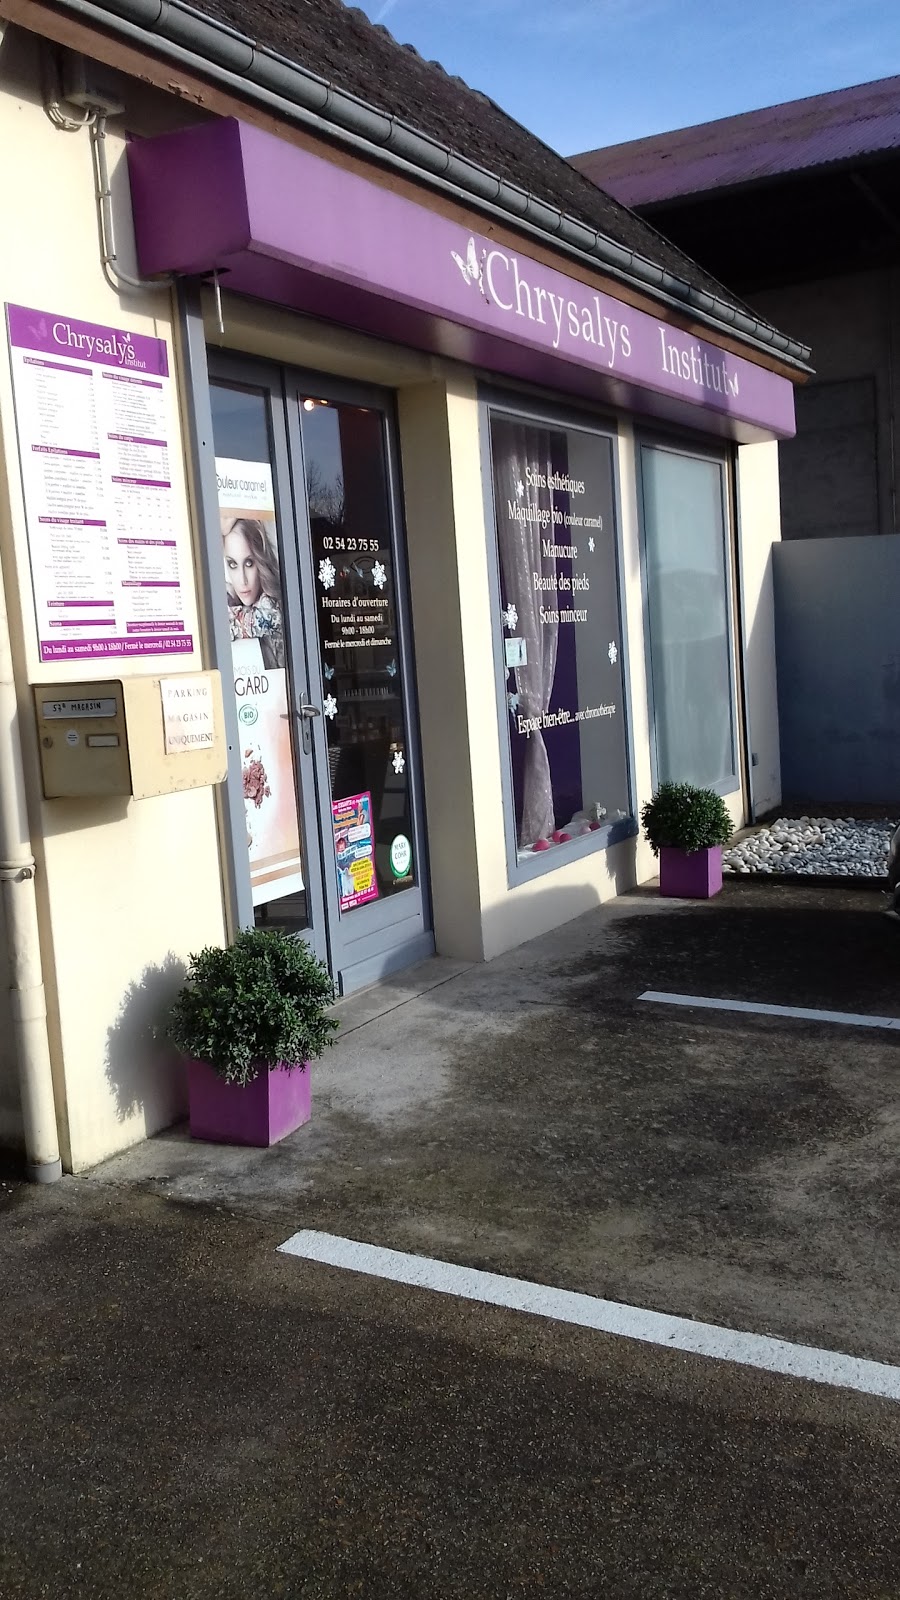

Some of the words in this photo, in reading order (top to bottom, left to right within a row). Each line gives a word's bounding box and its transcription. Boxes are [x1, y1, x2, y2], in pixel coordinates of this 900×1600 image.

[486, 251, 631, 368] Chrysalys
[658, 326, 729, 396] Institut
[53, 322, 135, 365] Chrysalys
[125, 357, 147, 369] Institut
[239, 479, 267, 493] caramel
[525, 467, 546, 490] Soins
[547, 471, 585, 499] esthétiques
[507, 500, 550, 530] Maquillage
[551, 506, 563, 525] bio
[563, 512, 583, 529] (couleur
[584, 515, 603, 531] caramel)
[323, 536, 334, 550] 02
[335, 537, 346, 550] 54
[346, 537, 357, 551] 23
[357, 538, 368, 551] 75
[369, 539, 379, 552] 55
[542, 538, 578, 559] Manucure
[533, 571, 558, 591] Beauté
[558, 571, 571, 591] des
[571, 572, 590, 597] pieds
[321, 596, 351, 608] Horaires
[352, 596, 388, 608] d'ouverture
[330, 614, 340, 624] Du
[340, 613, 356, 623] lundi
[356, 615, 363, 623] au
[363, 613, 383, 622] samedi
[540, 605, 559, 624] Soins
[560, 605, 588, 623] minceur
[341, 626, 355, 635] 9h00
[43, 645, 52, 654] Du
[53, 644, 67, 653] lundi
[75, 643, 92, 653] samedi
[124, 641, 139, 650] Fermé
[324, 640, 340, 649] Fermé
[345, 638, 366, 648] mercredi
[371, 637, 392, 647] dimanche
[234, 675, 269, 696] GARD
[167, 688, 208, 698] PARKING
[71, 702, 101, 711] MAGASIN
[168, 712, 209, 723] MAGASIN
[244, 711, 254, 719] BIO
[517, 714, 543, 739] Espace
[585, 702, 616, 720] chromothérapie
[168, 733, 213, 746] UNIQUEMENT
